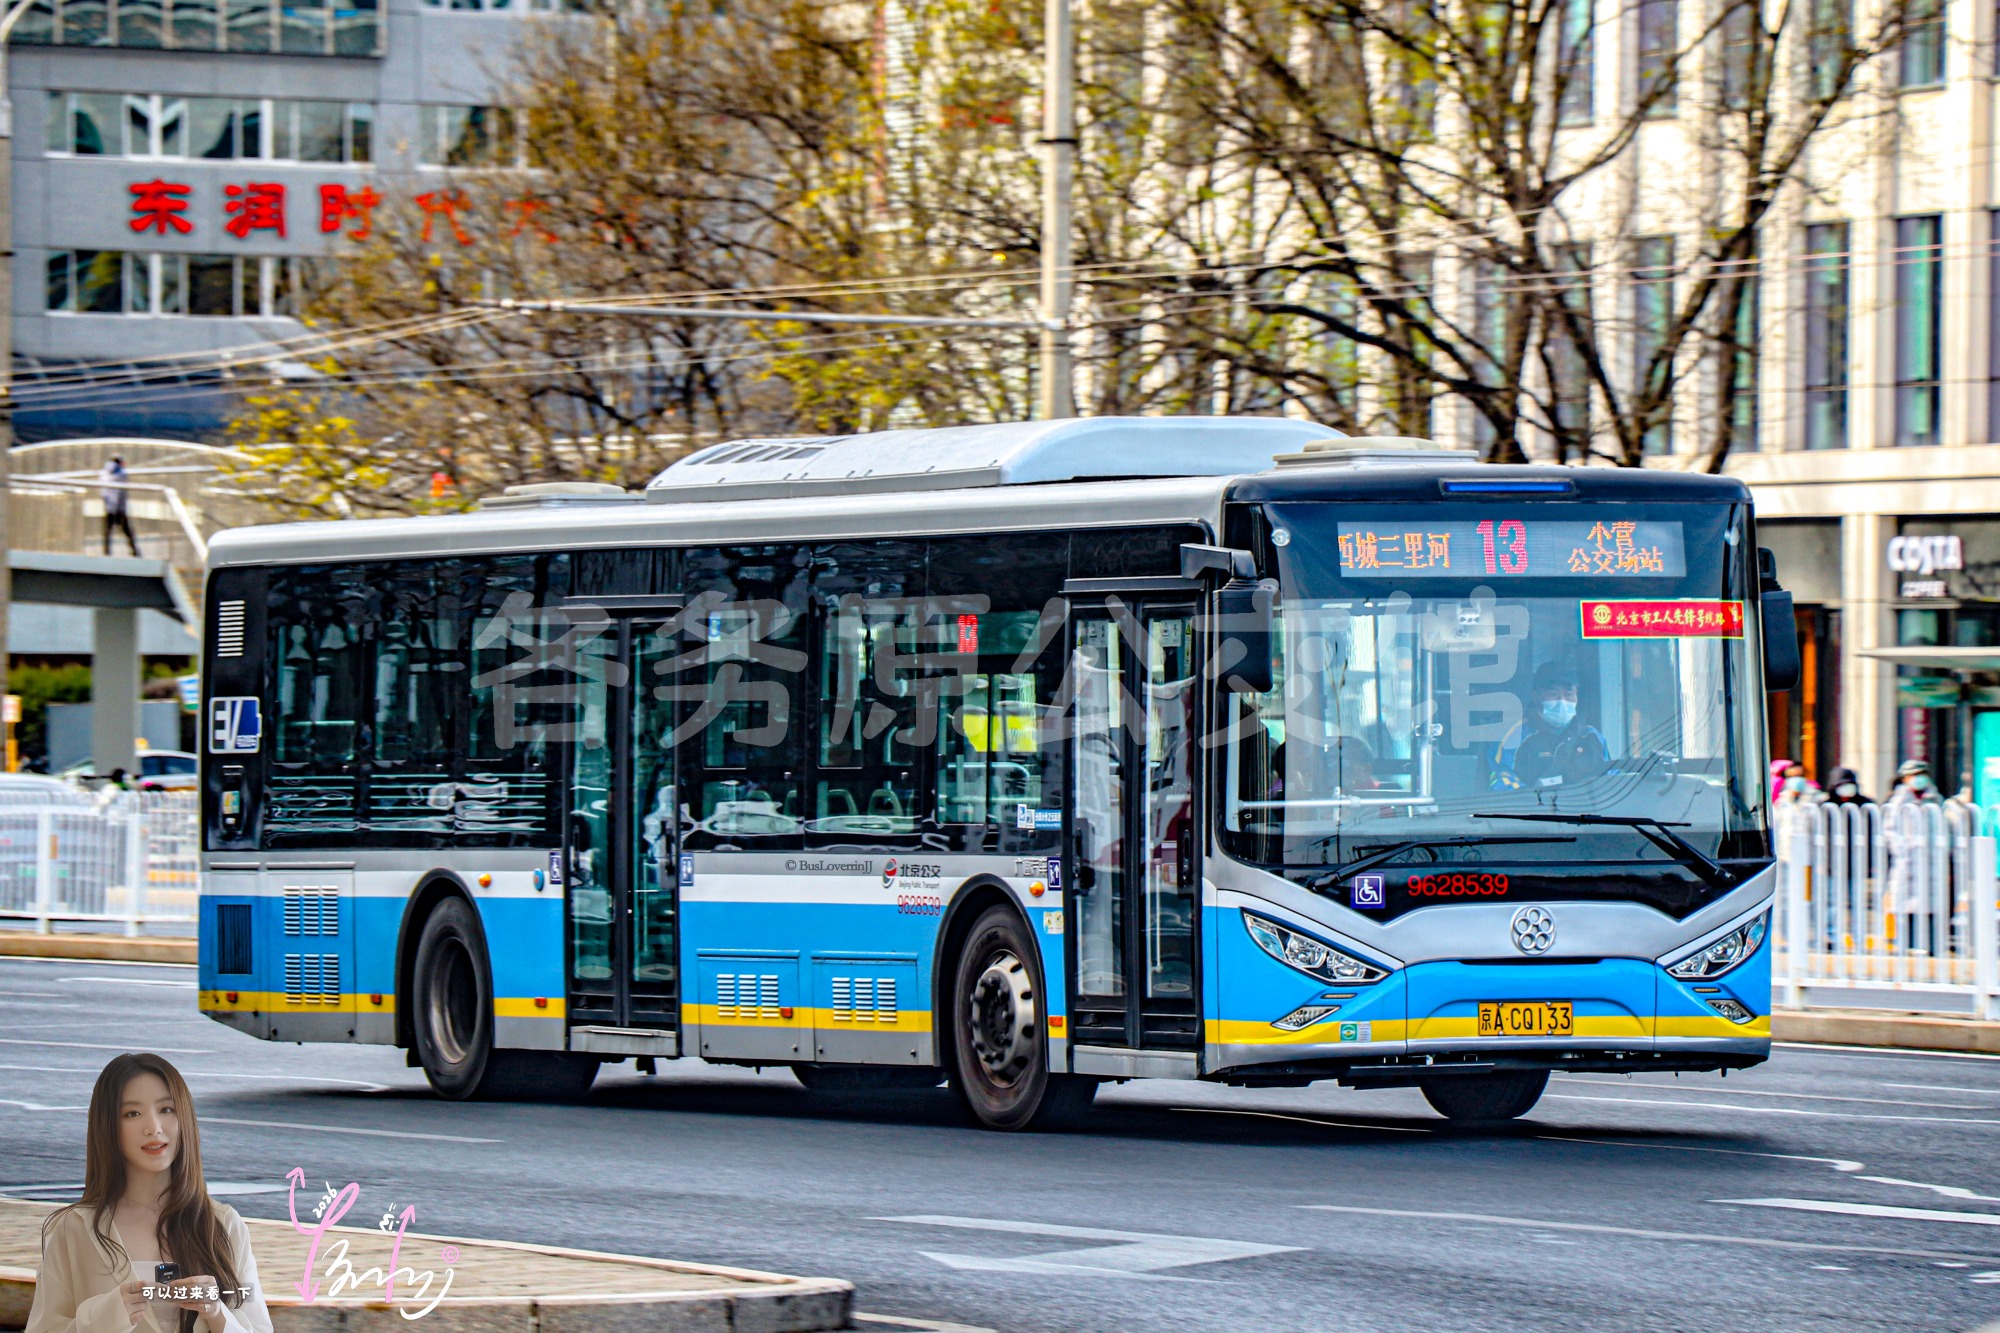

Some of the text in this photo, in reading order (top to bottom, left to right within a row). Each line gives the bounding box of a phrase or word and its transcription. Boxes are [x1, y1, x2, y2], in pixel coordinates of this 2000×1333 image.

[128, 179, 652, 246] 东润时代大
[1476, 520, 1528, 574] 13
[1587, 521, 1636, 547] 小营
[1568, 546, 1664, 574] 公交场站
[1887, 535, 1963, 575] COSTA
[900, 864, 941, 878] 北京公交
[1407, 874, 1509, 896] 9628539
[897, 894, 941, 917] 9628539
[1481, 1007, 1571, 1031] 京A·CQ133
